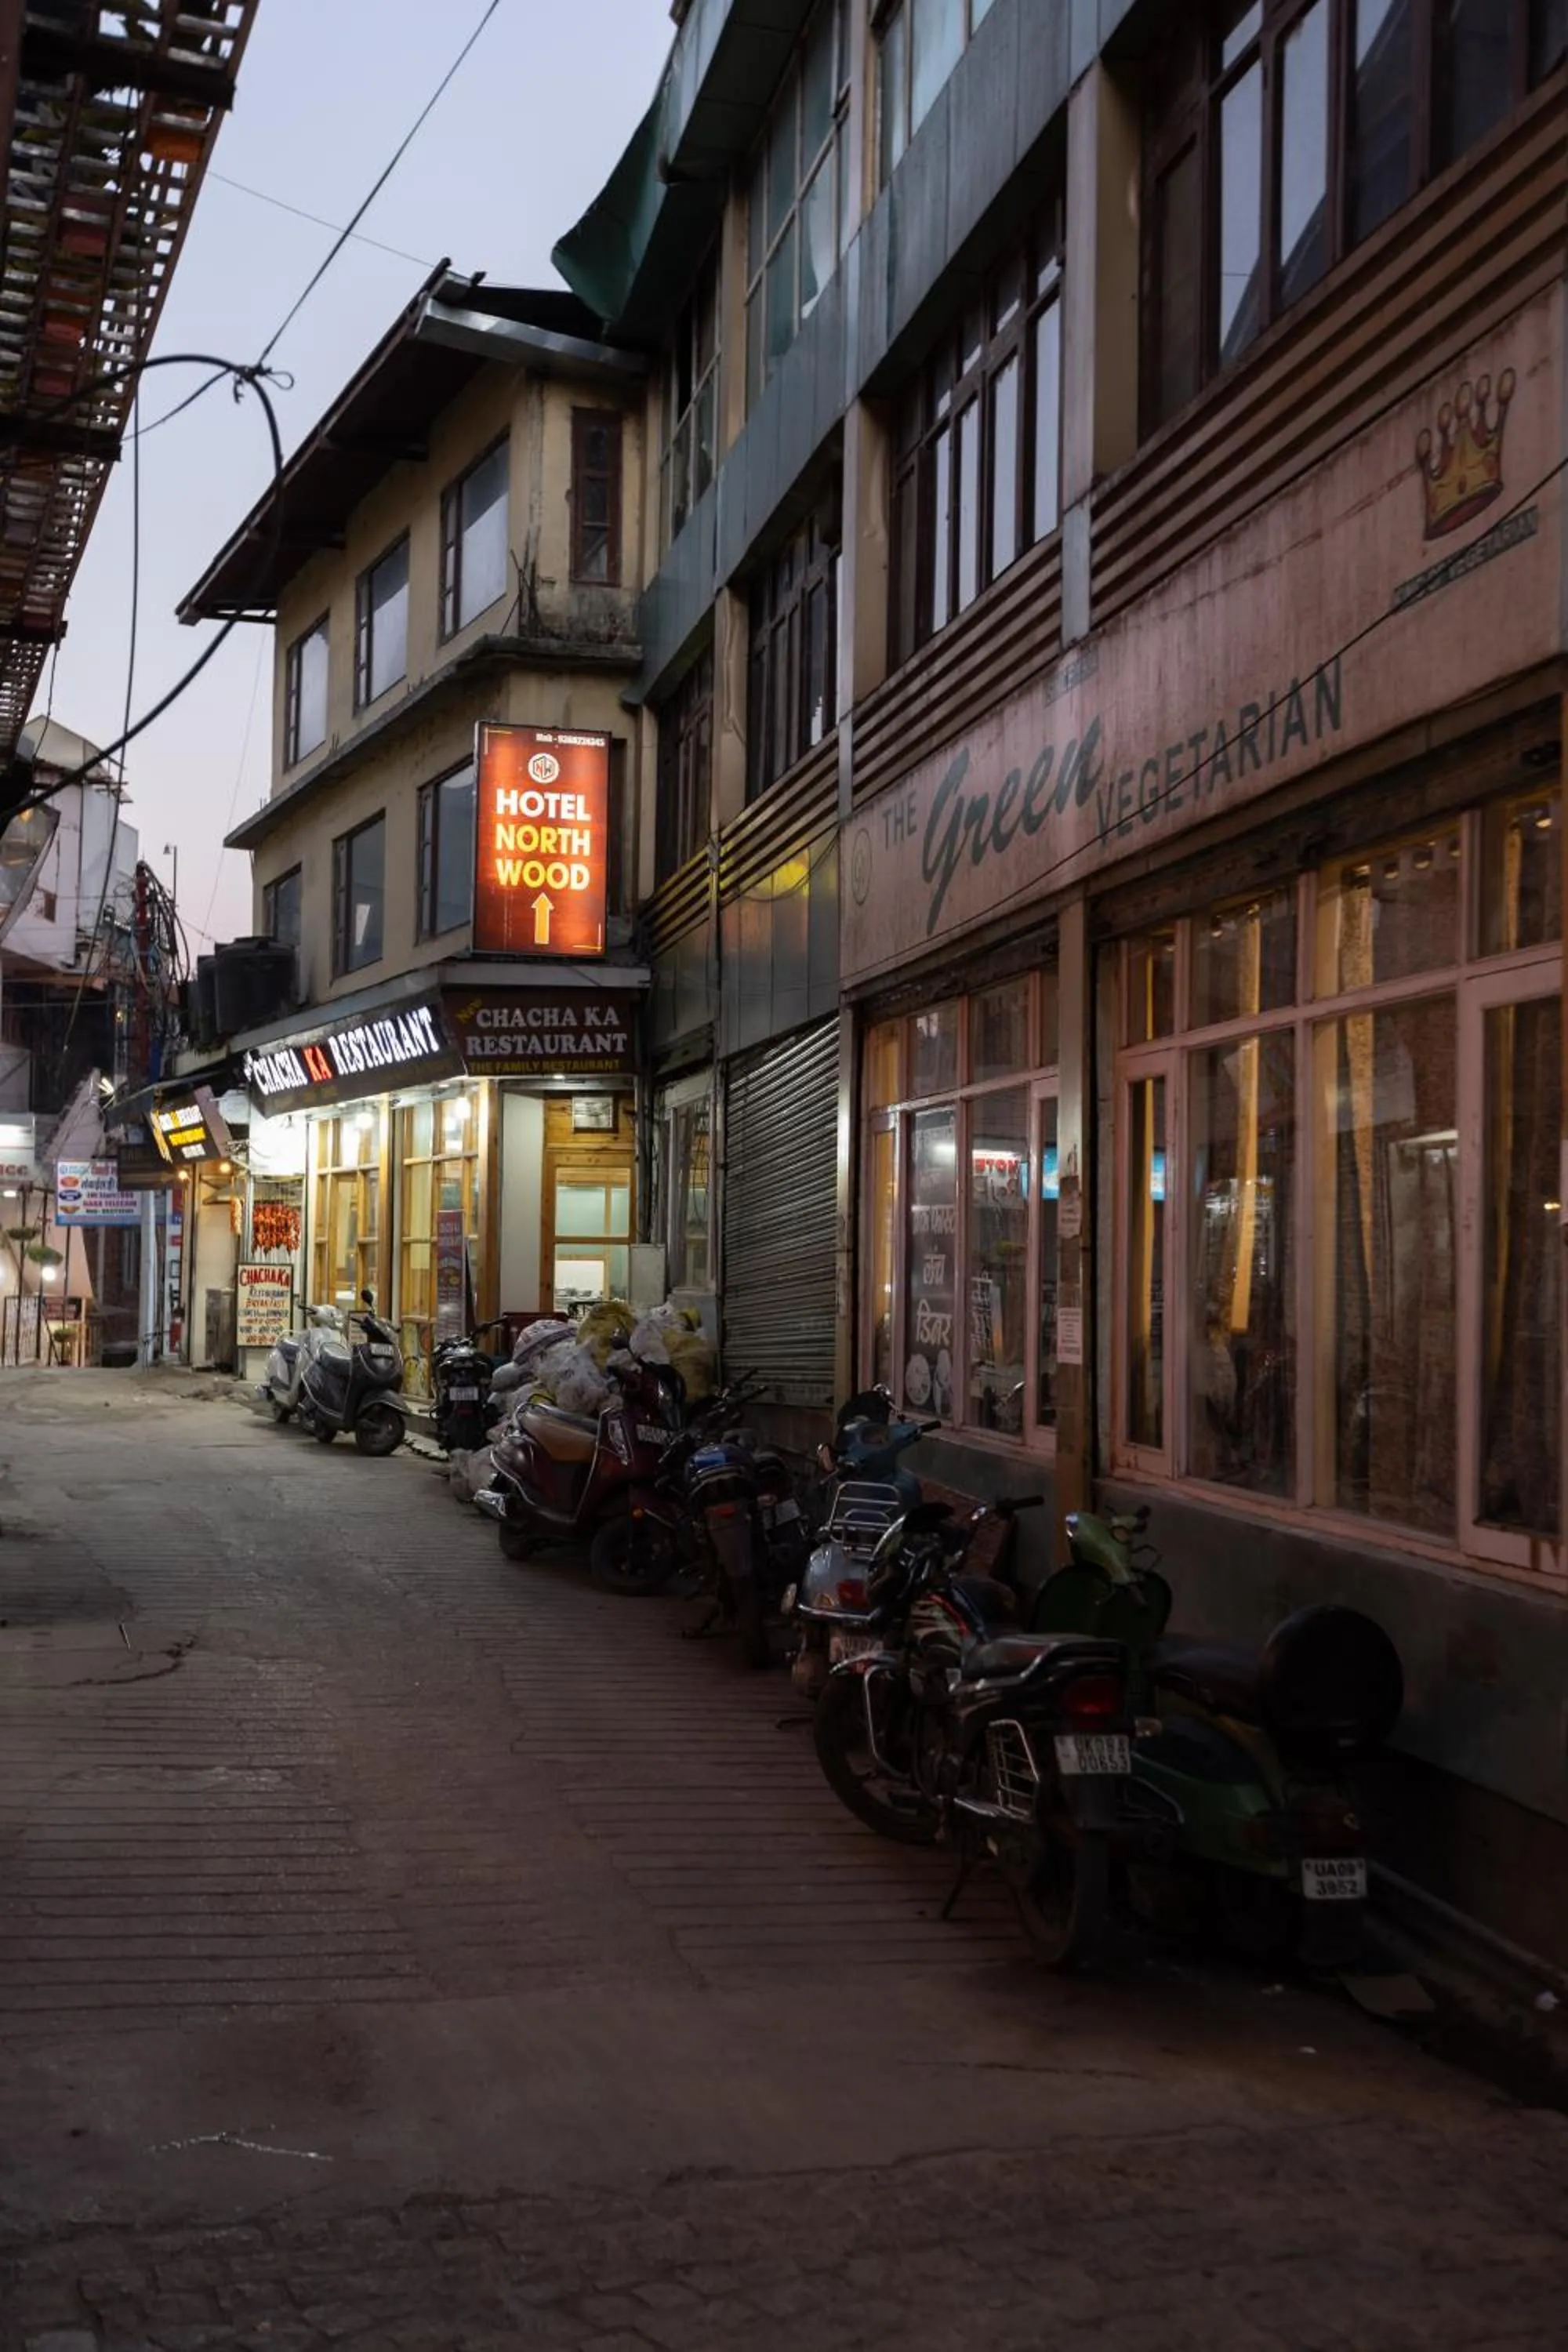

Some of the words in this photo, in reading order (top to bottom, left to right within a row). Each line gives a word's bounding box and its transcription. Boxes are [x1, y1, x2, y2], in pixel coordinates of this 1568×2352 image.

[1097, 655, 1342, 847] VEGETARIAN
[495, 788, 592, 821] HOTEL
[495, 823, 591, 857] NORTH
[883, 786, 918, 851] THE
[922, 714, 1105, 935] Green
[495, 858, 590, 891] WOOD
[476, 1006, 578, 1029] CHACHA
[583, 1004, 621, 1027] KA
[252, 1048, 308, 1096] CHACHA
[303, 1045, 332, 1083] KA
[327, 1009, 440, 1076] RESTAURANT
[465, 1033, 628, 1056] RESTAURANT
[470, 1061, 492, 1073] THE
[495, 1060, 540, 1073] FAMILY
[542, 1058, 621, 1072] RESTAURANT
